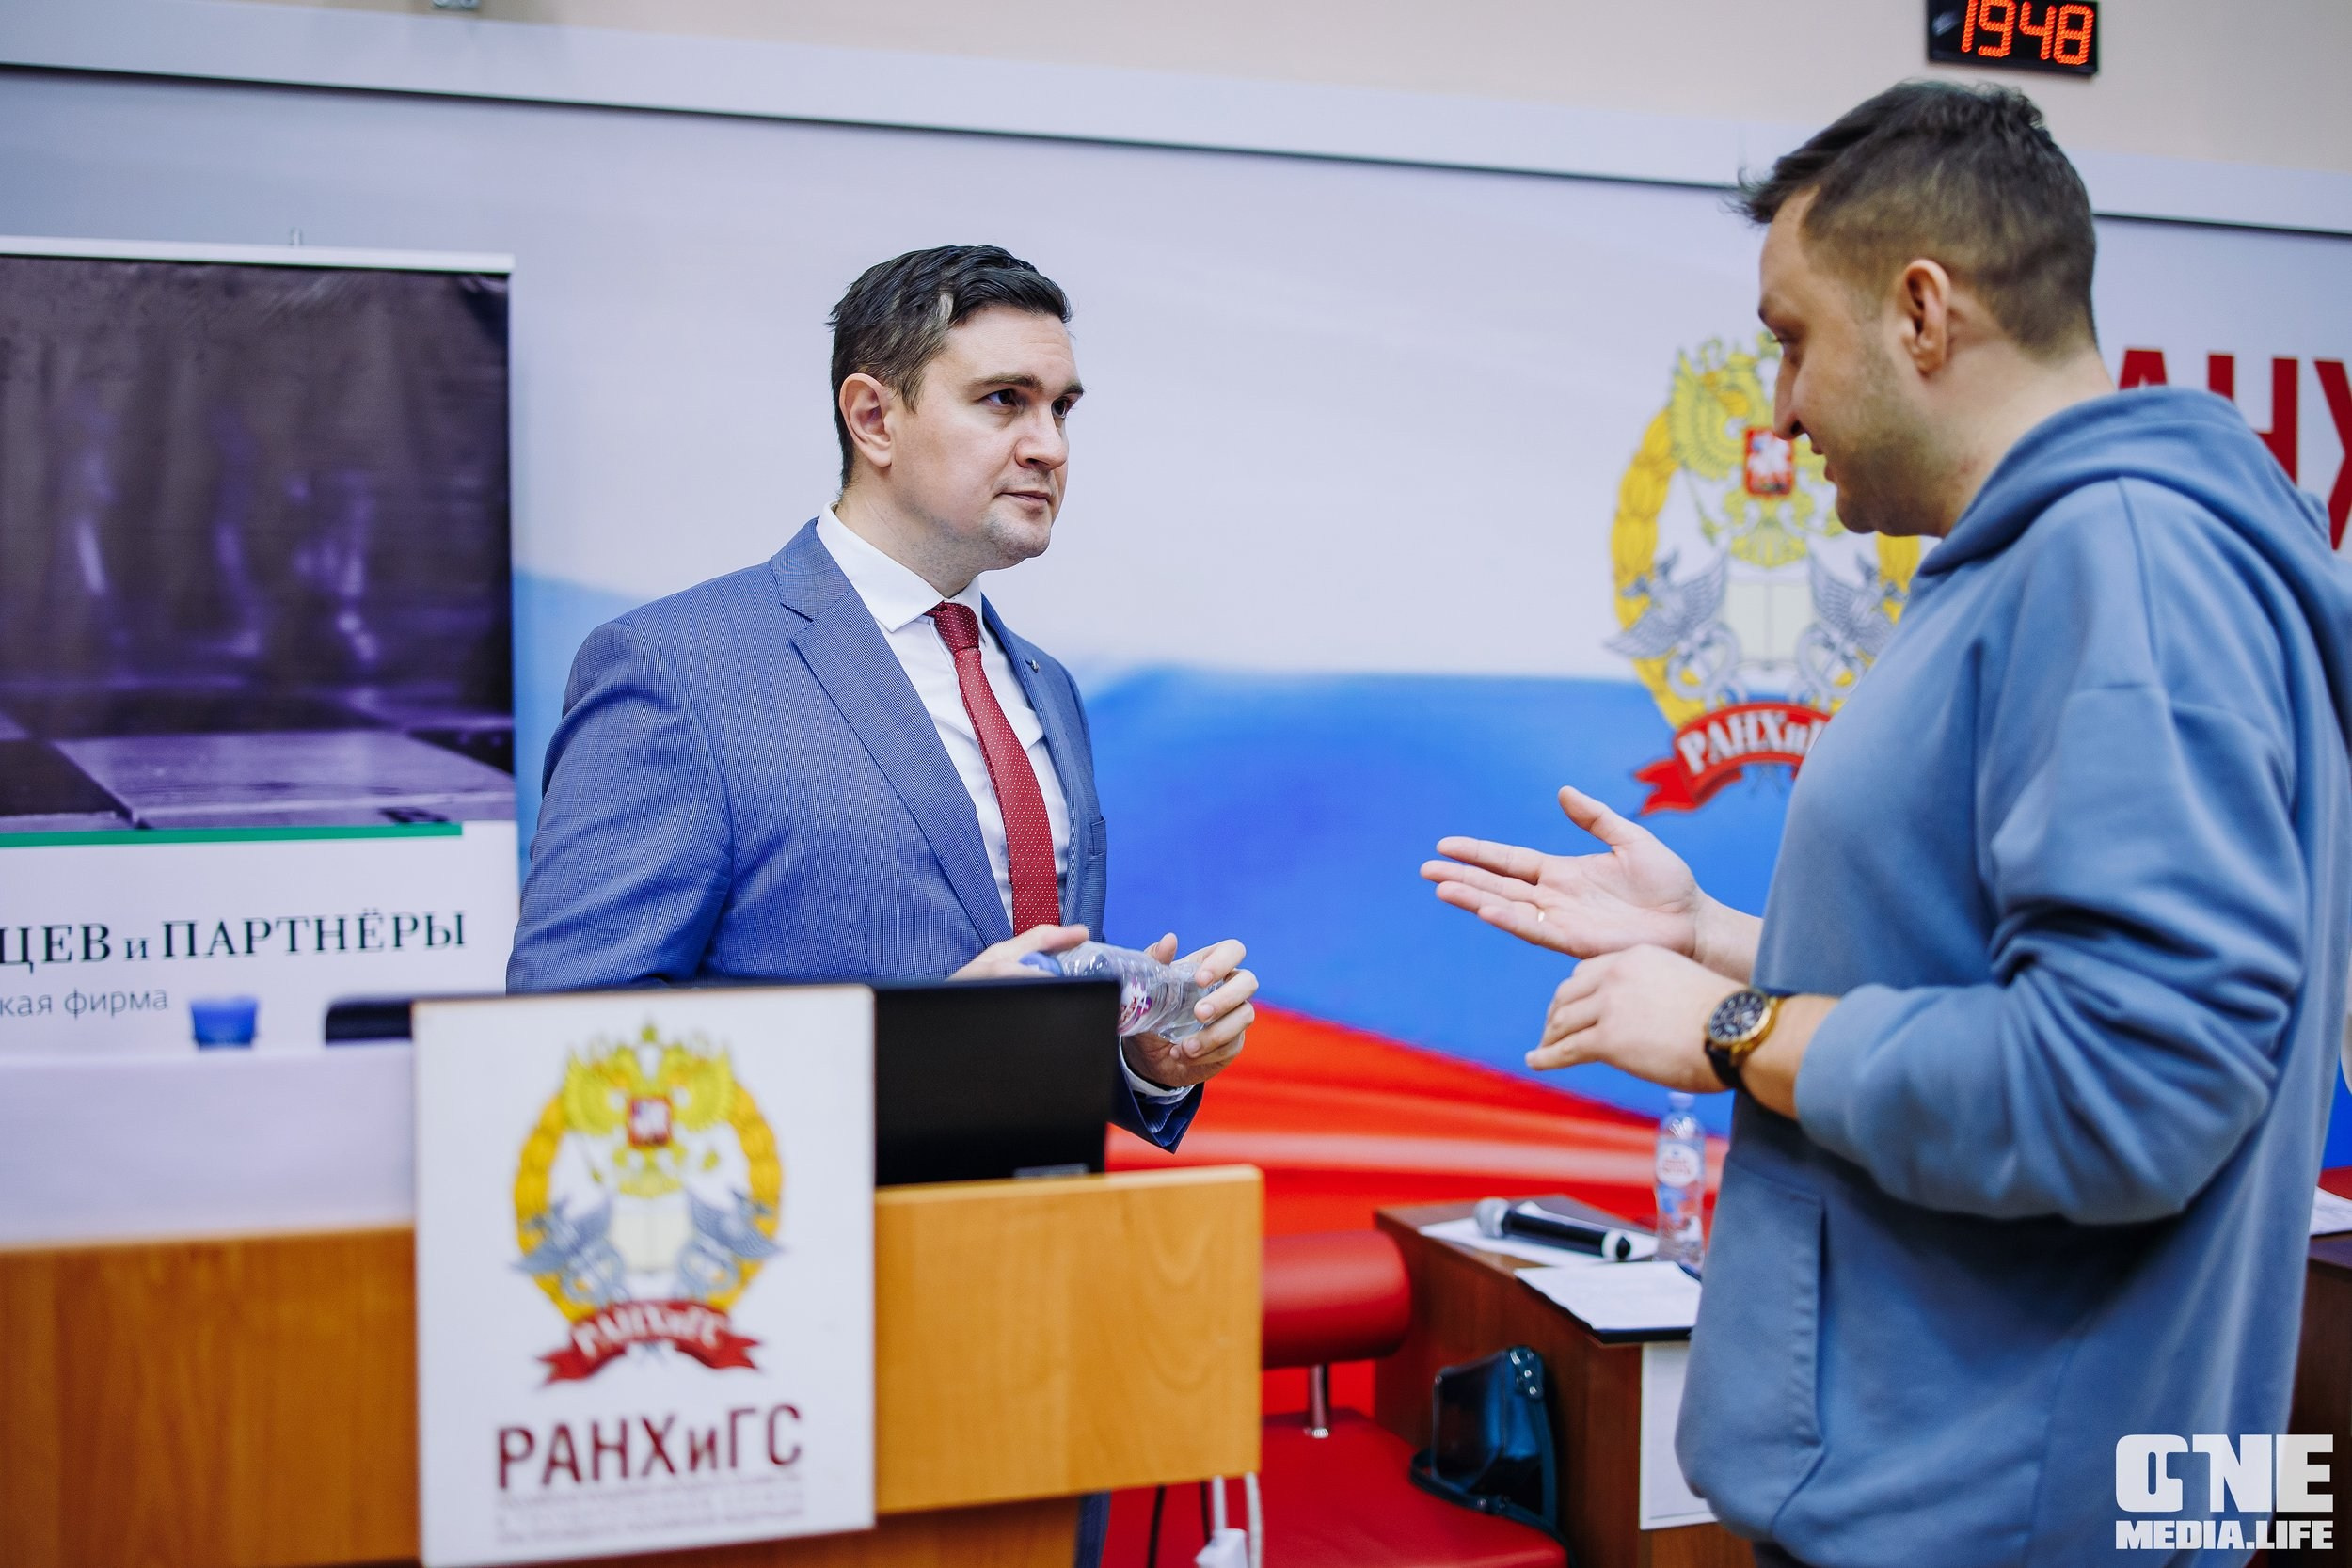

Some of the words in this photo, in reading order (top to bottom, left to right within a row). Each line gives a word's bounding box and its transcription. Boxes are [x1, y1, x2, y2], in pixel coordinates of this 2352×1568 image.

[123, 937, 151, 960] и
[161, 908, 467, 960] ПАРТНЁРЫ
[63, 988, 168, 1020] фирма
[497, 1403, 803, 1491] РАНХиГС
